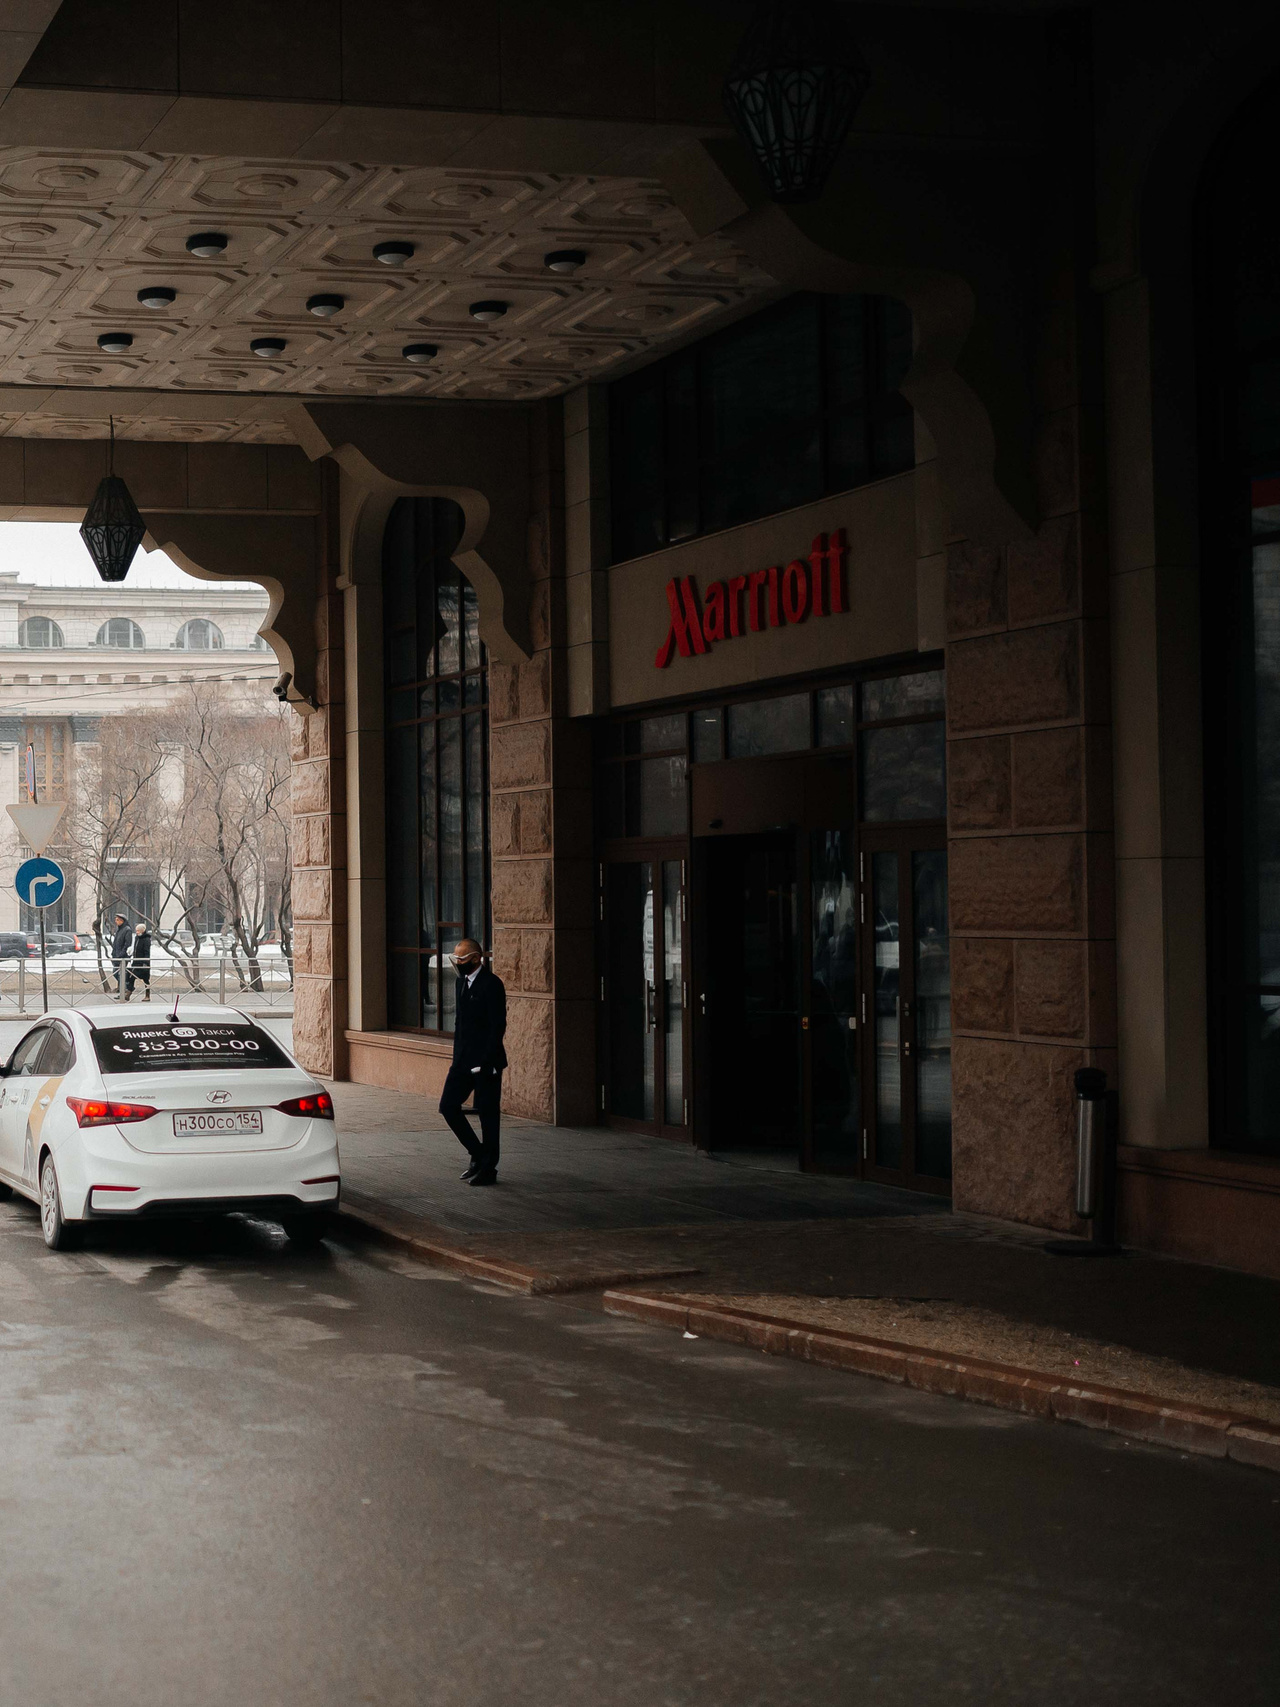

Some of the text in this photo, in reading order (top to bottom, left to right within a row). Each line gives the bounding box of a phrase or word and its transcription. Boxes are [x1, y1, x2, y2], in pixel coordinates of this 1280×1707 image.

[654, 527, 851, 669] Marriott
[123, 1031, 170, 1039] Яндекс
[198, 1028, 235, 1036] Такси
[179, 1113, 259, 1130] Н300СО 154
